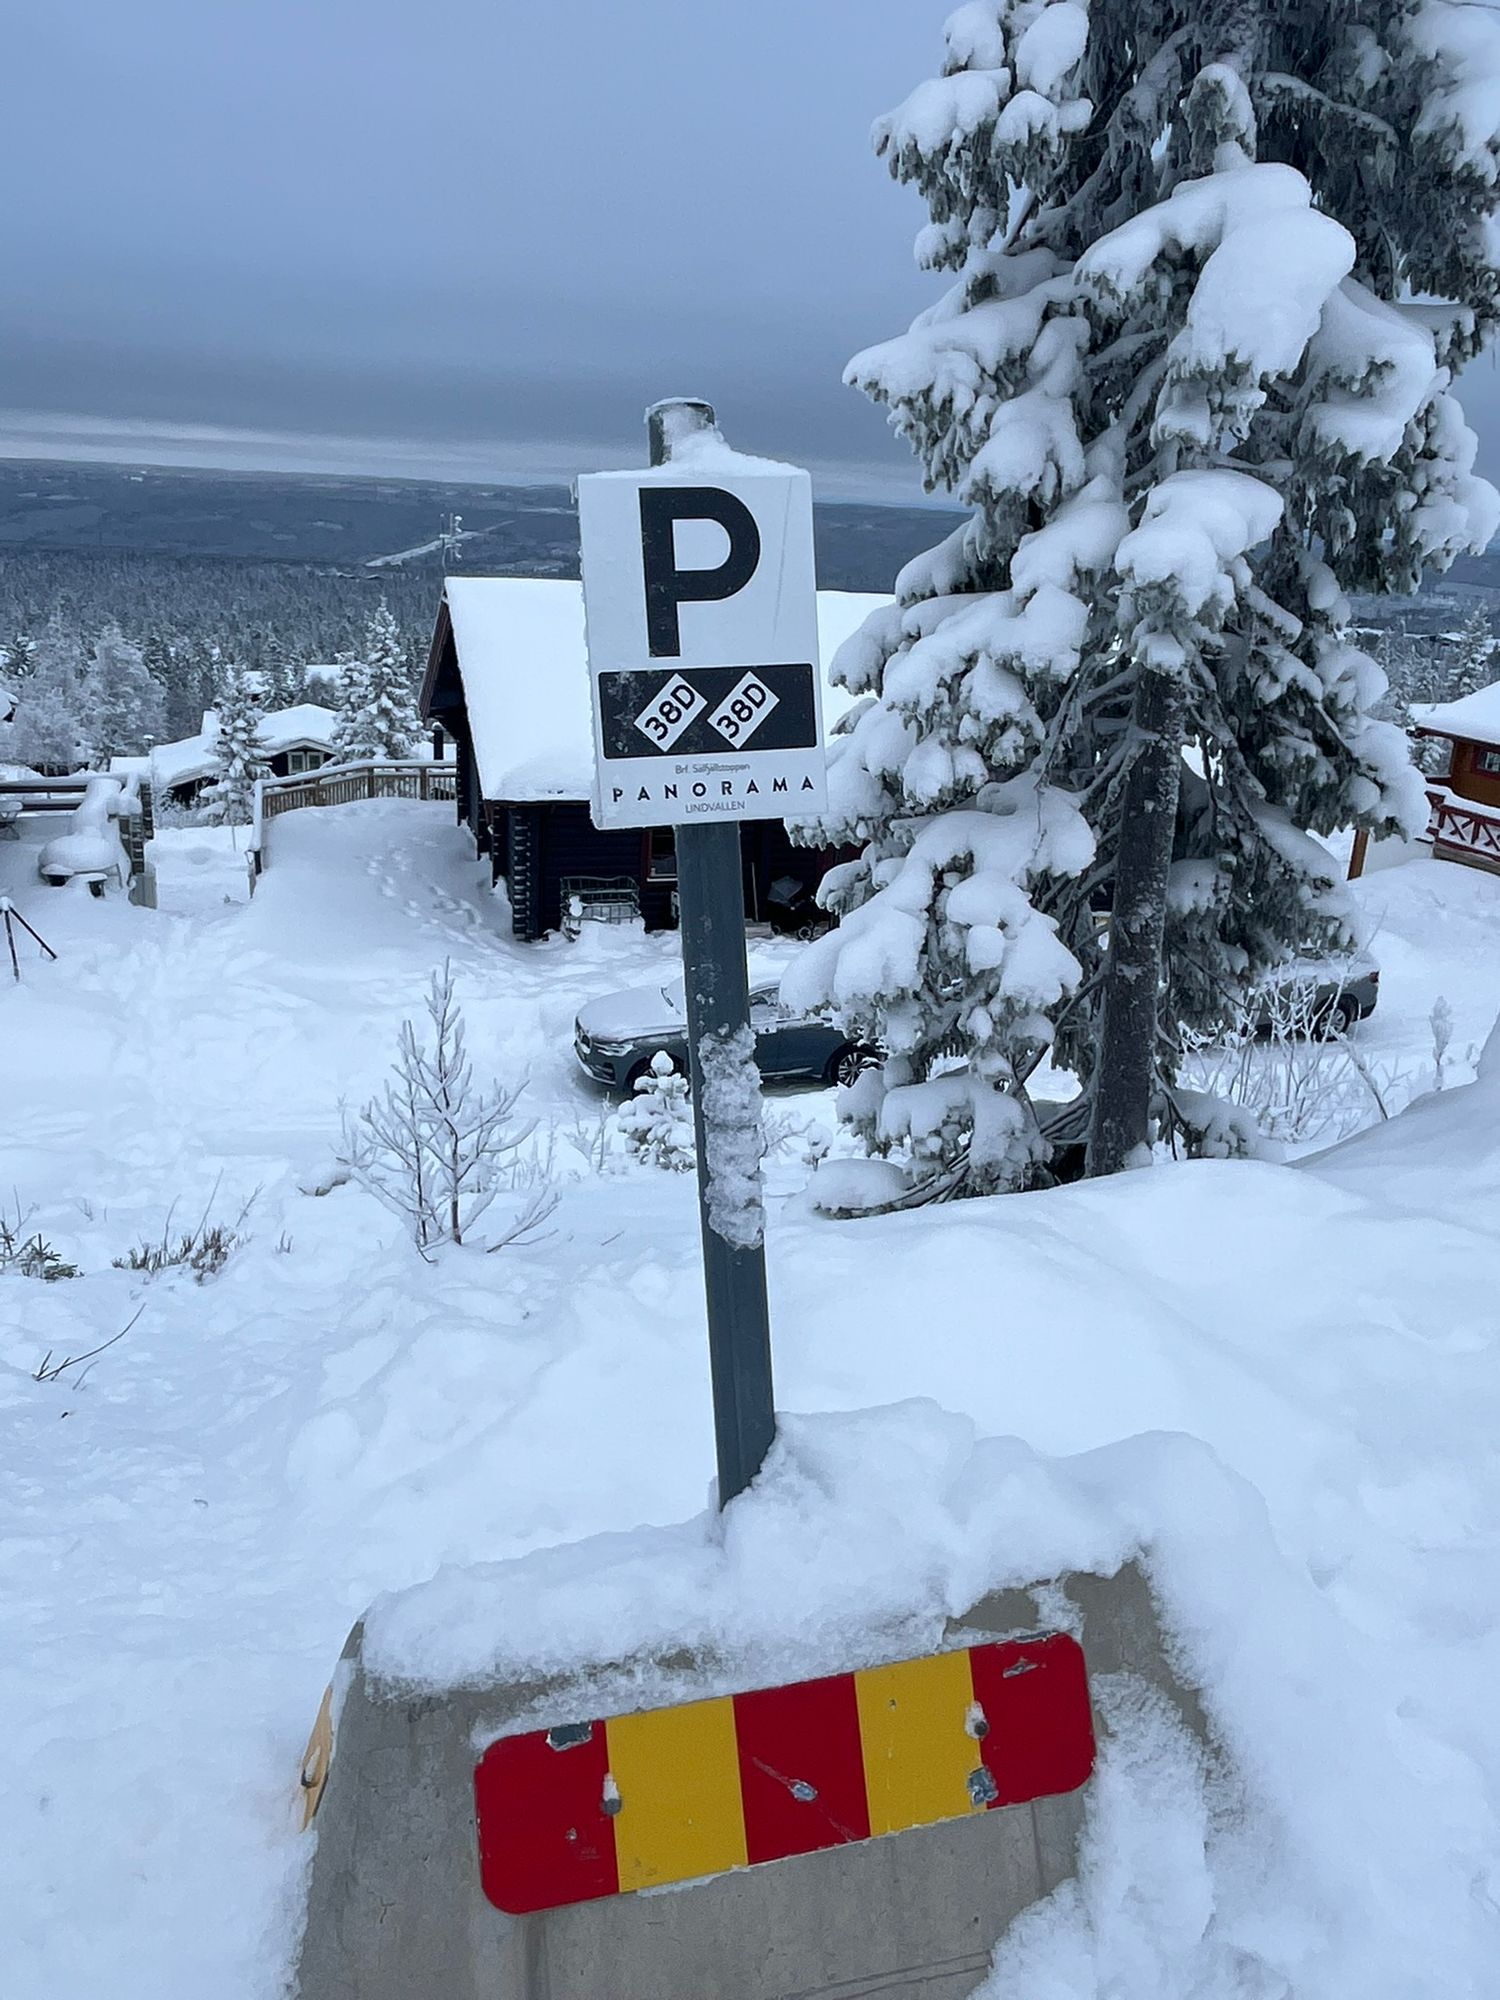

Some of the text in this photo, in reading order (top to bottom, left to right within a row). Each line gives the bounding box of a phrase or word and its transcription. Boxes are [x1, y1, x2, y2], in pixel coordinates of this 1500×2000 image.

[638, 486, 760, 658] P
[644, 684, 696, 741] 38D
[716, 683, 766, 740] 38D
[613, 776, 814, 803] PANORAMA
[685, 801, 745, 813] LINDVALLEN
